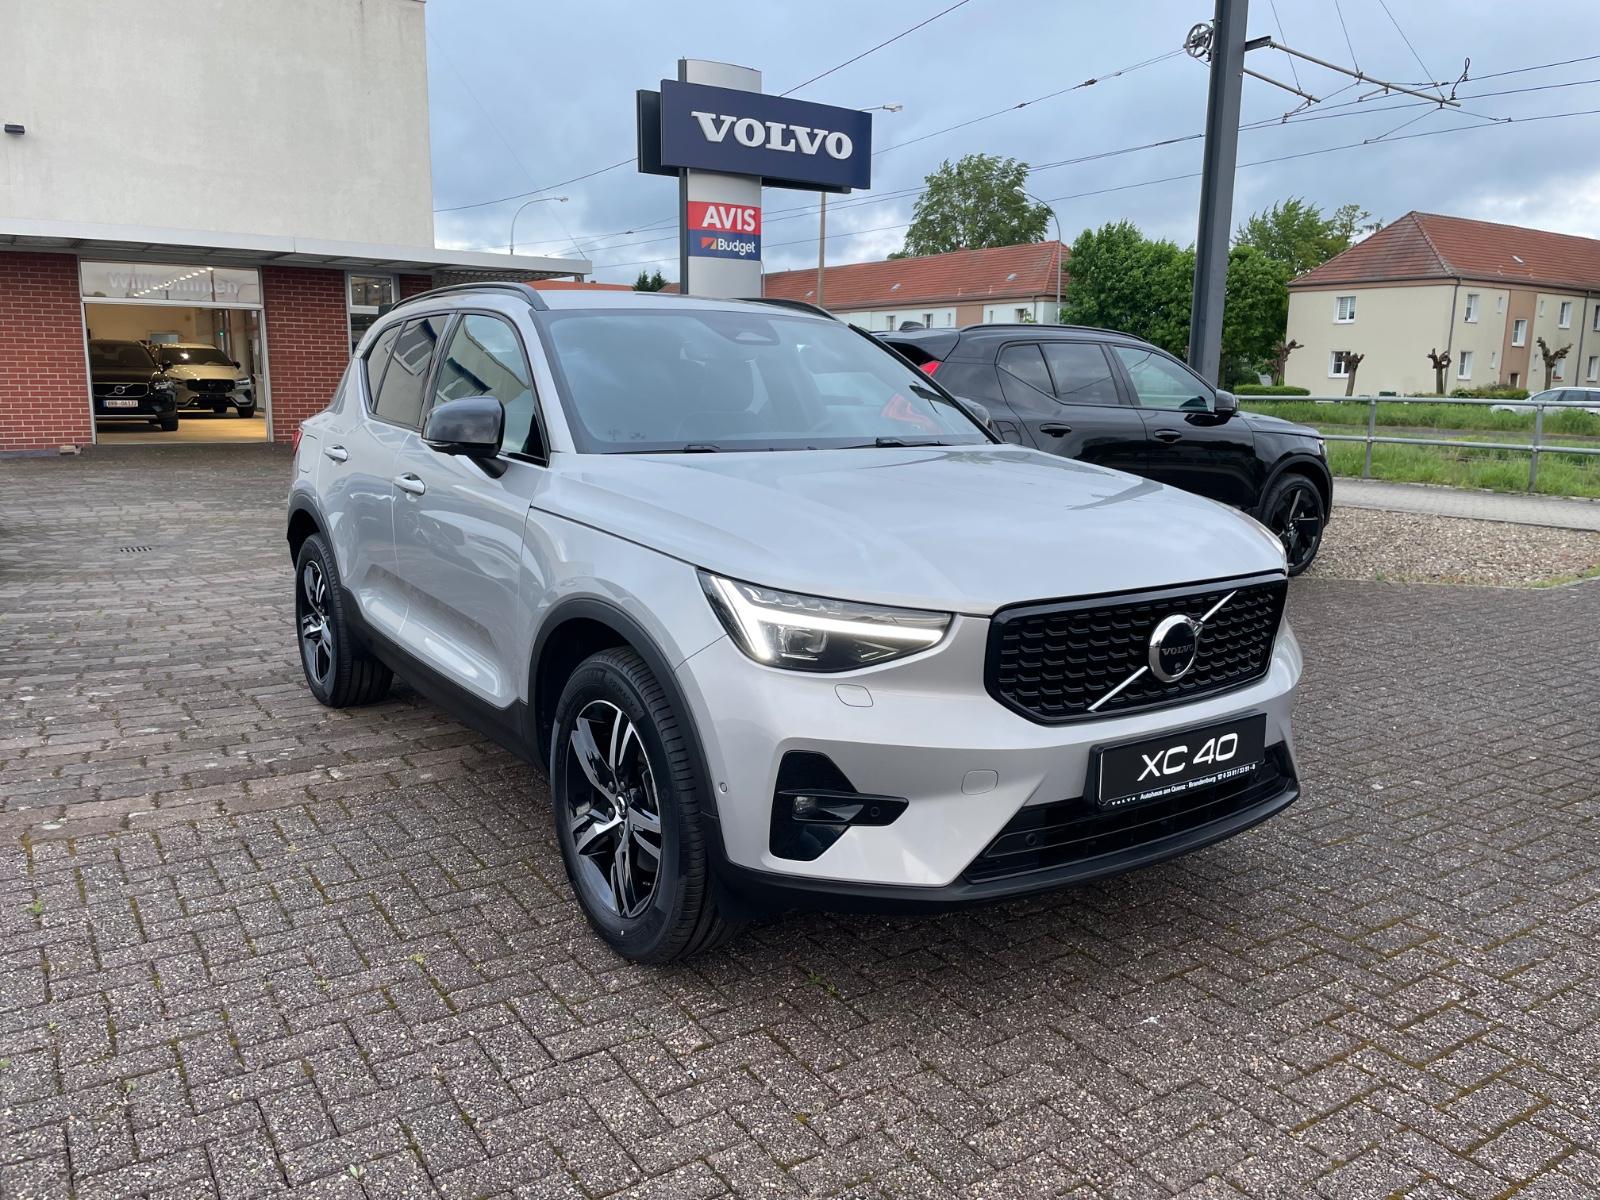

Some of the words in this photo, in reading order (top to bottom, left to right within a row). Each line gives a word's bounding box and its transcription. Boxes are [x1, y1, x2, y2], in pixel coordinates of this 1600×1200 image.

[691, 111, 853, 160] VOLVO
[702, 206, 756, 232] AVIS
[718, 238, 756, 256] Budget
[1161, 644, 1193, 655] VOLVO
[1137, 745, 1188, 782] XC
[1193, 733, 1238, 765] 40
[1140, 790, 1163, 800] Autohaus
[1188, 777, 1216, 788] Brandenburg
